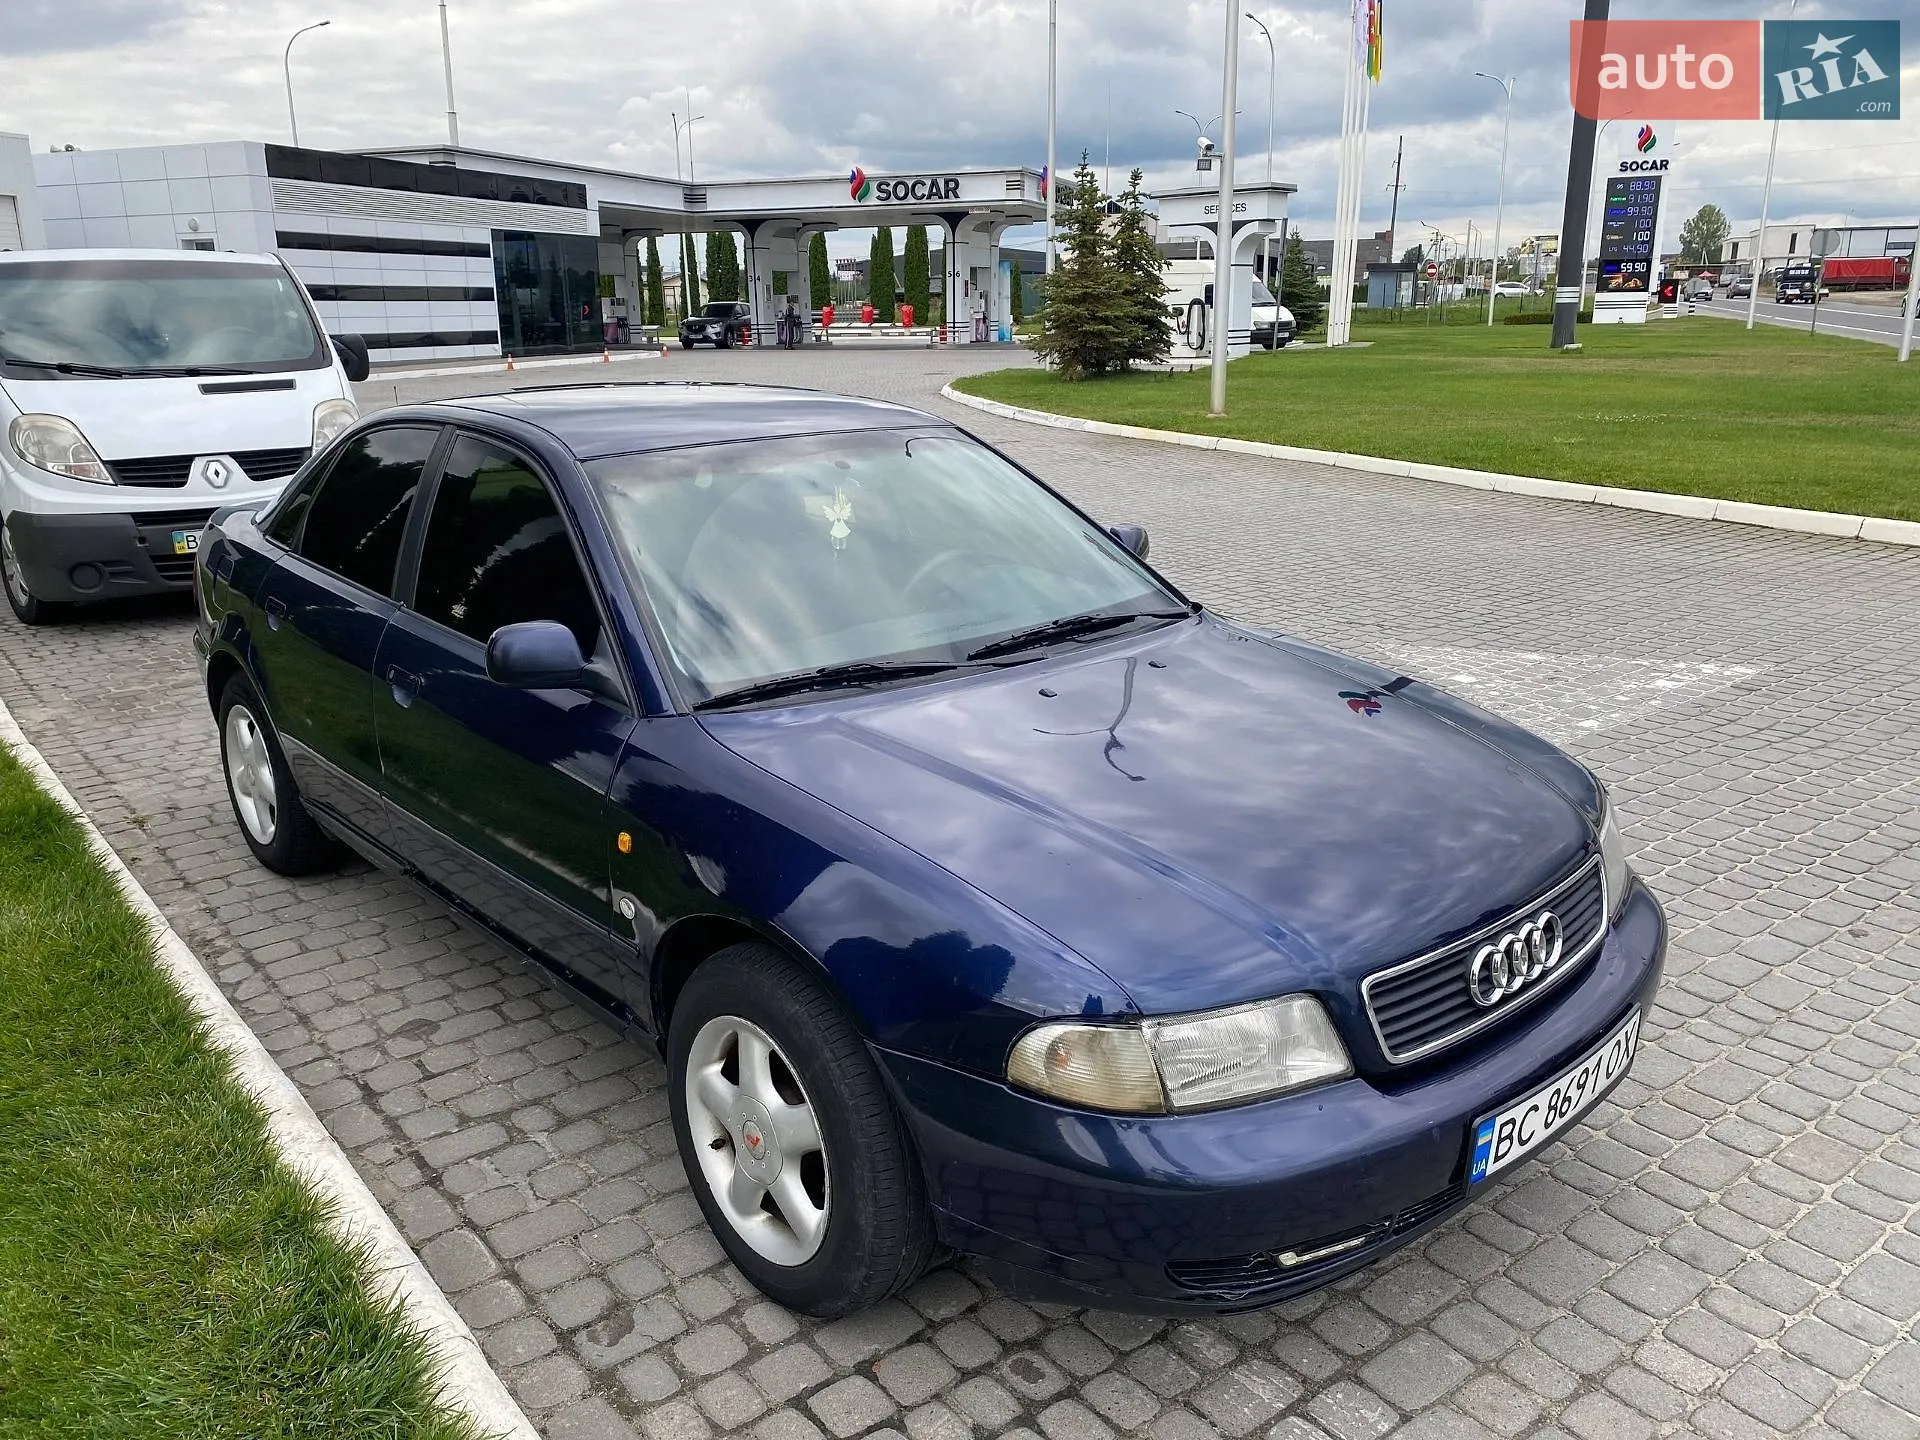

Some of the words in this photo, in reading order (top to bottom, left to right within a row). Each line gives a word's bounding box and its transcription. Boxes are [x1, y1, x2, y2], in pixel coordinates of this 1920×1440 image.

[1619, 159, 1669, 172] SOCAR
[875, 178, 960, 201] SOCAR
[1630, 181, 1656, 190] 88.90
[1204, 203, 1247, 215] SERCES
[1635, 219, 1651, 228] 100
[1633, 231, 1650, 241] 100
[1620, 262, 1647, 272] 59.90
[186, 535, 201, 549] B
[1492, 1103, 1539, 1164] BC
[1544, 1056, 1602, 1130] 8691
[1606, 1021, 1636, 1080] OX
[1473, 1158, 1486, 1175] UA
